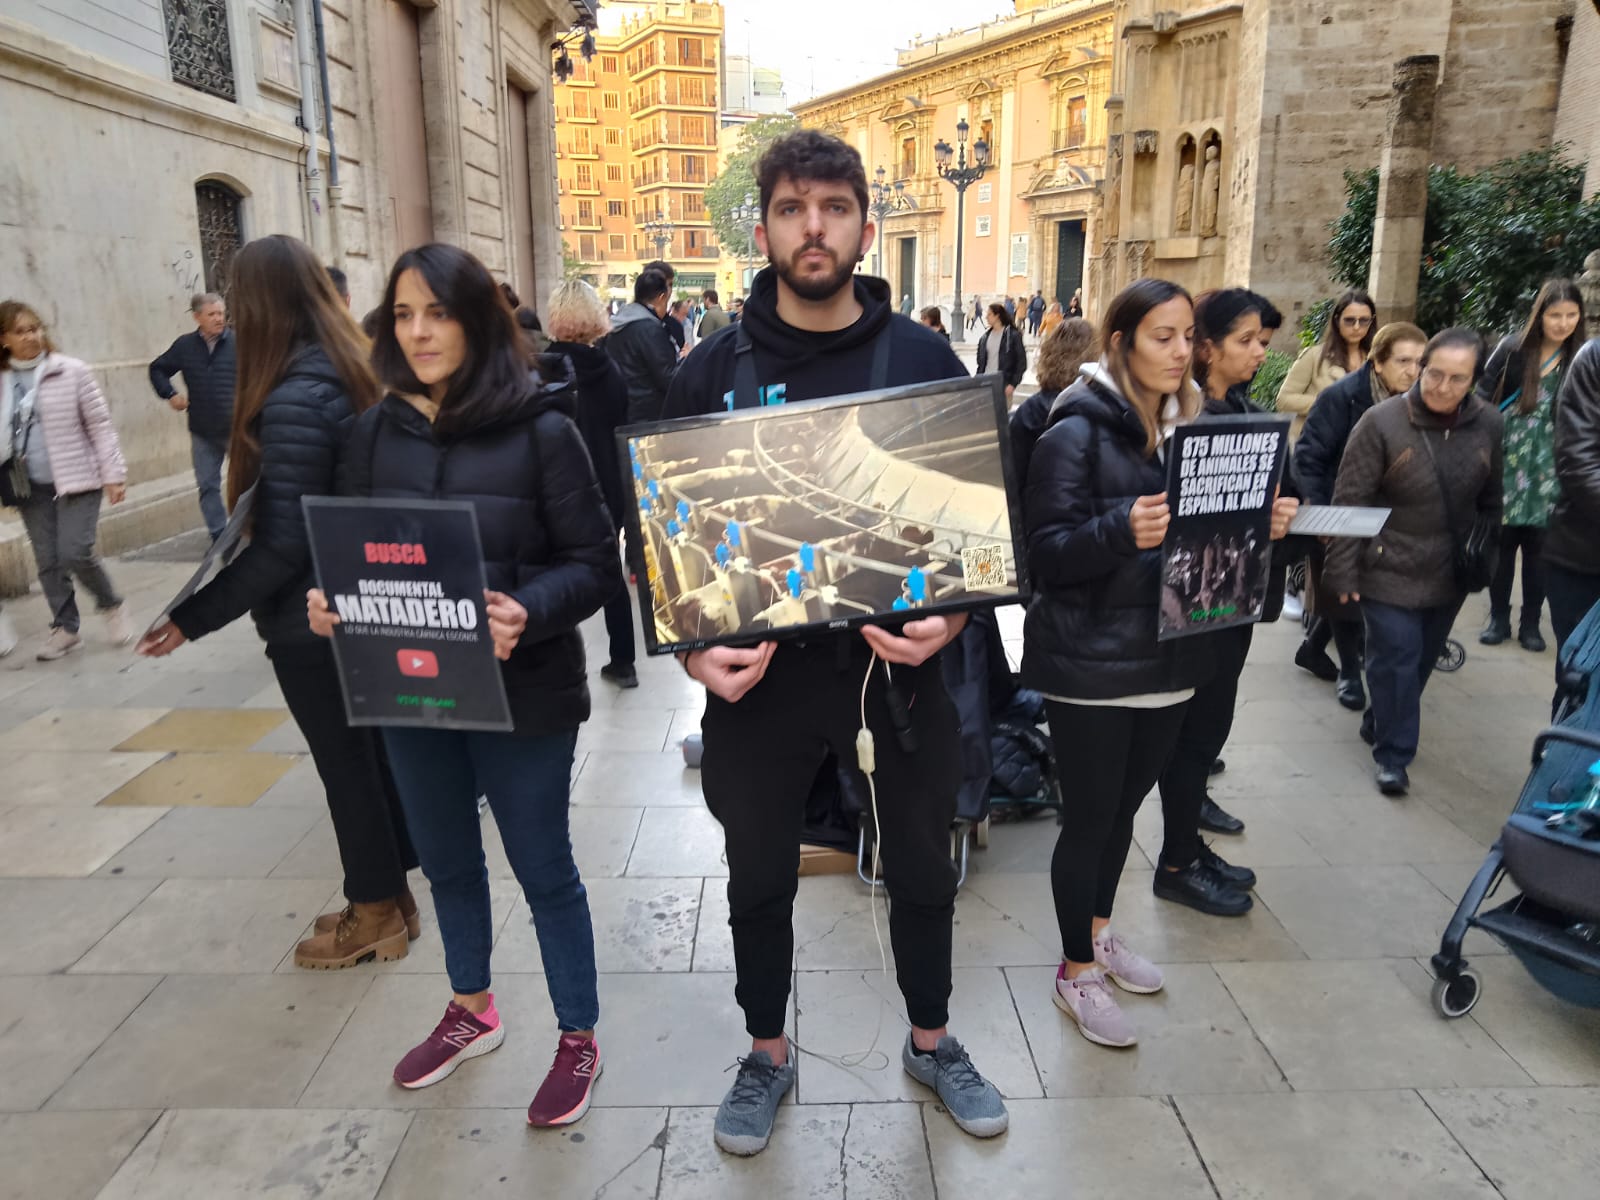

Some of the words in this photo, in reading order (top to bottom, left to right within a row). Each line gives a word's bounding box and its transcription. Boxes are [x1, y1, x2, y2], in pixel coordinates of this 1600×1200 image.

[1182, 436, 1210, 458] 875
[1211, 432, 1280, 456] MILLONES
[1180, 459, 1197, 478] DE
[1197, 454, 1258, 476] ANIMALES
[1258, 453, 1276, 471] SE
[1180, 473, 1252, 497] SACRIFICAN
[1252, 472, 1270, 490] EN
[1224, 492, 1240, 512] AL
[1240, 488, 1266, 510] AÑO
[363, 542, 428, 565] BUSCA
[358, 579, 445, 598] DOCUMENTAL
[334, 594, 478, 630] MATADERO
[370, 626, 380, 636] LA
